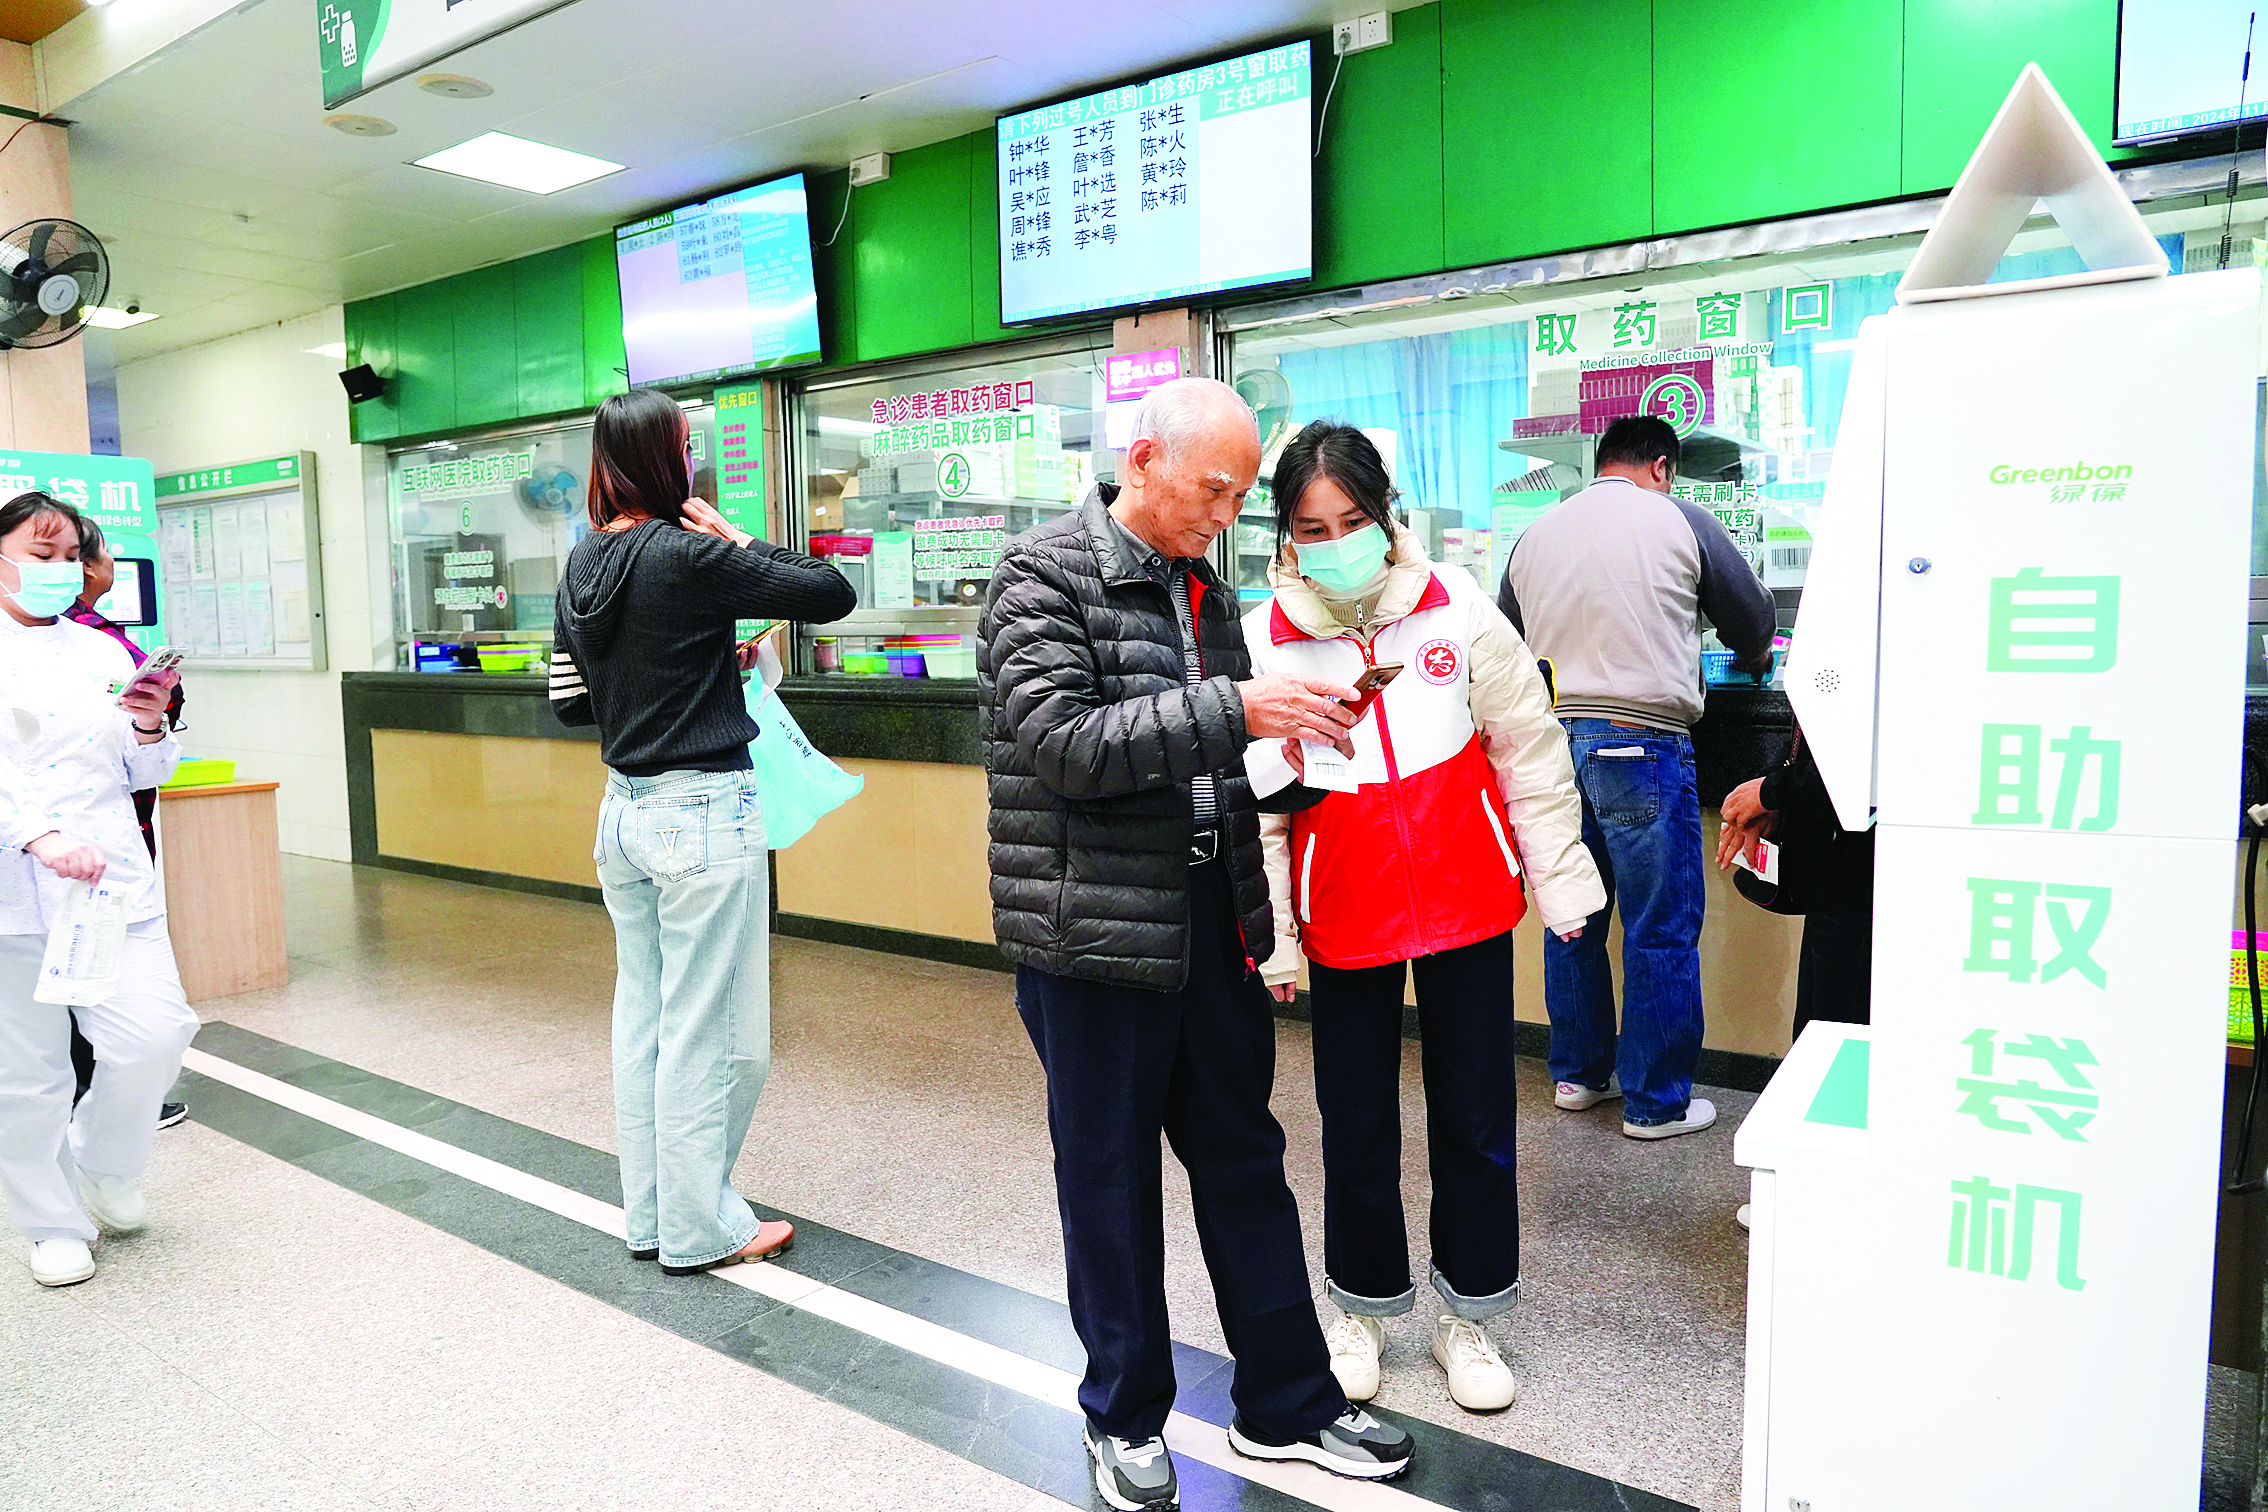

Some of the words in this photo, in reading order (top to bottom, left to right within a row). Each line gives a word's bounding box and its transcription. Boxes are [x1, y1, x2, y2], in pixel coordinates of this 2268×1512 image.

[998, 43, 1310, 140] 请下列过号人员到门诊药房3号窗取药
[1216, 75, 1299, 114] 正在呼叫
[1535, 284, 1831, 357] 取药窗口
[1580, 355, 1638, 371] Medicine
[1641, 347, 1711, 367] Collection
[1714, 341, 1772, 358] Window
[718, 391, 757, 410] 优先窗口
[871, 380, 1034, 424] 急诊患者取药窗口
[1658, 386, 1687, 428] 3
[873, 414, 1035, 455] 麻醉药品取药窗口
[403, 453, 532, 491] 互联网医院取药窗口
[1989, 461, 2132, 485] Greenbon
[916, 531, 1005, 549] 缴费成功无需刷卡
[1947, 567, 2122, 1292] 自助取袋机
